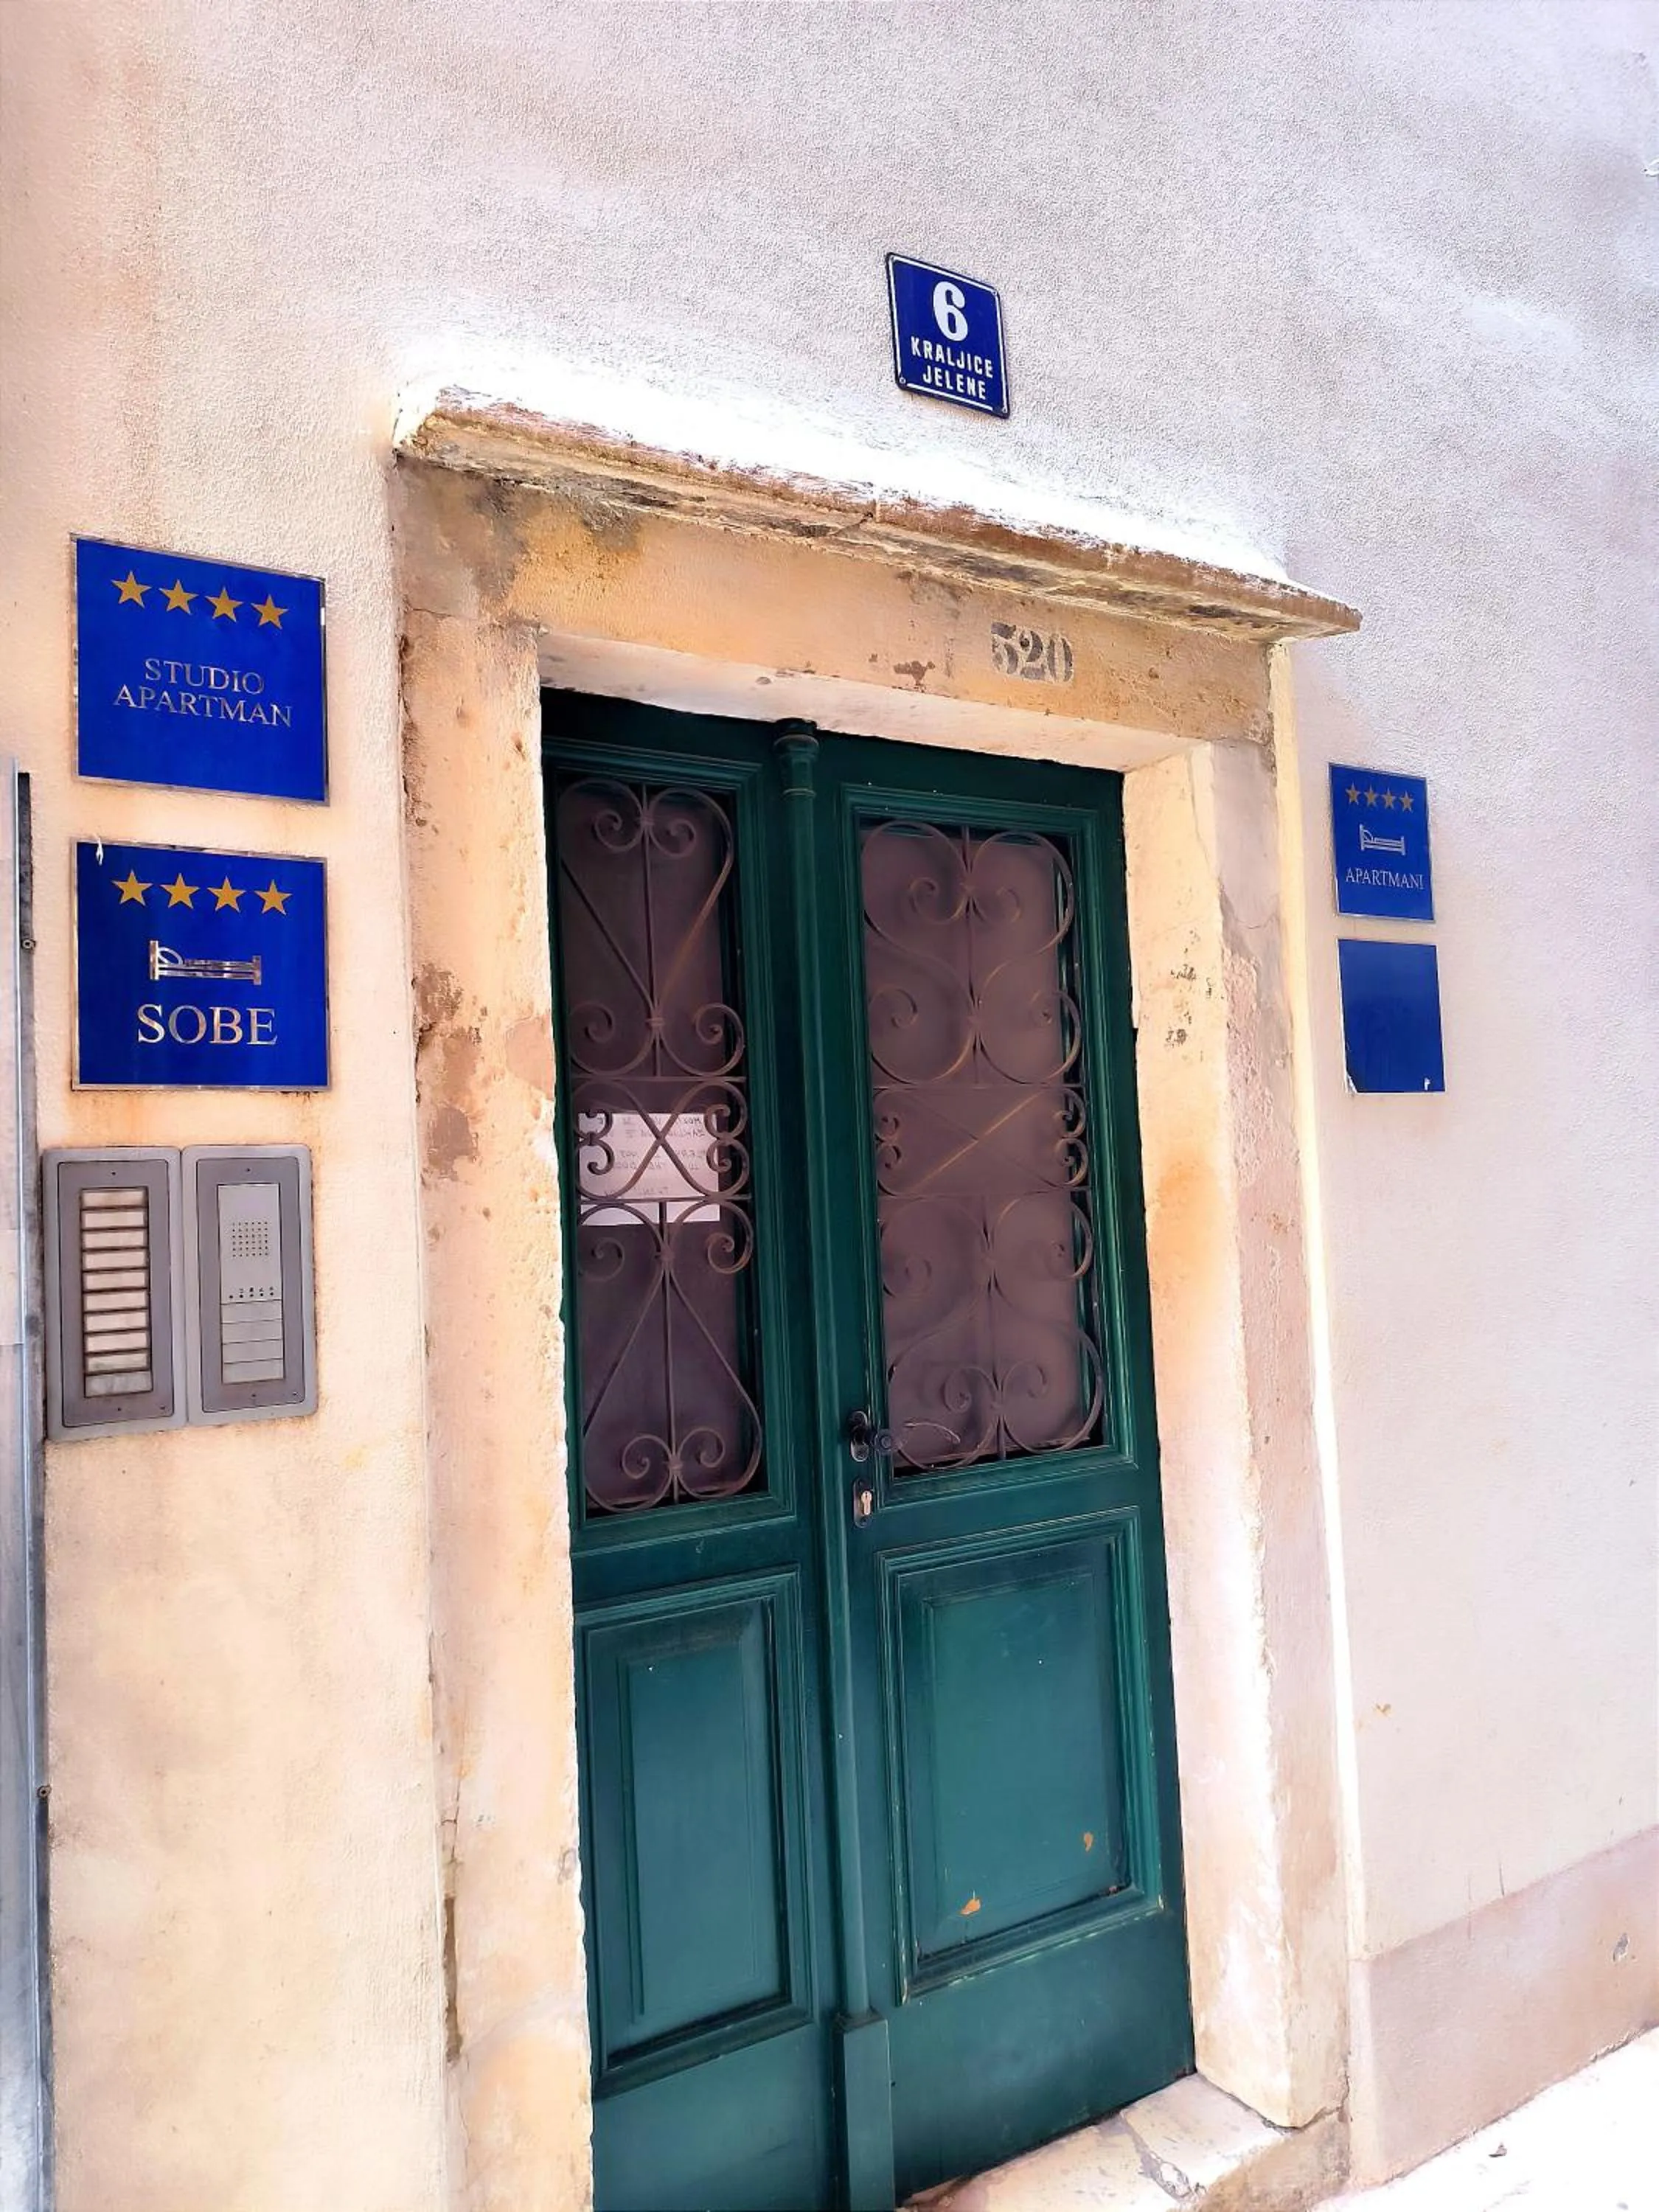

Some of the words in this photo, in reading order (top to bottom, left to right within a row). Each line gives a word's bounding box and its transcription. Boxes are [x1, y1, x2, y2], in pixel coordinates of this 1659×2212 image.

[933, 281, 968, 341] 6
[911, 336, 993, 378] KRALJICE
[923, 365, 986, 400] JELENE
[991, 622, 1073, 682] 520
[145, 658, 264, 695] STUDIO
[114, 685, 293, 728] APARTMAN
[1346, 867, 1424, 889] APARTMANI
[138, 1004, 278, 1045] SOBE
